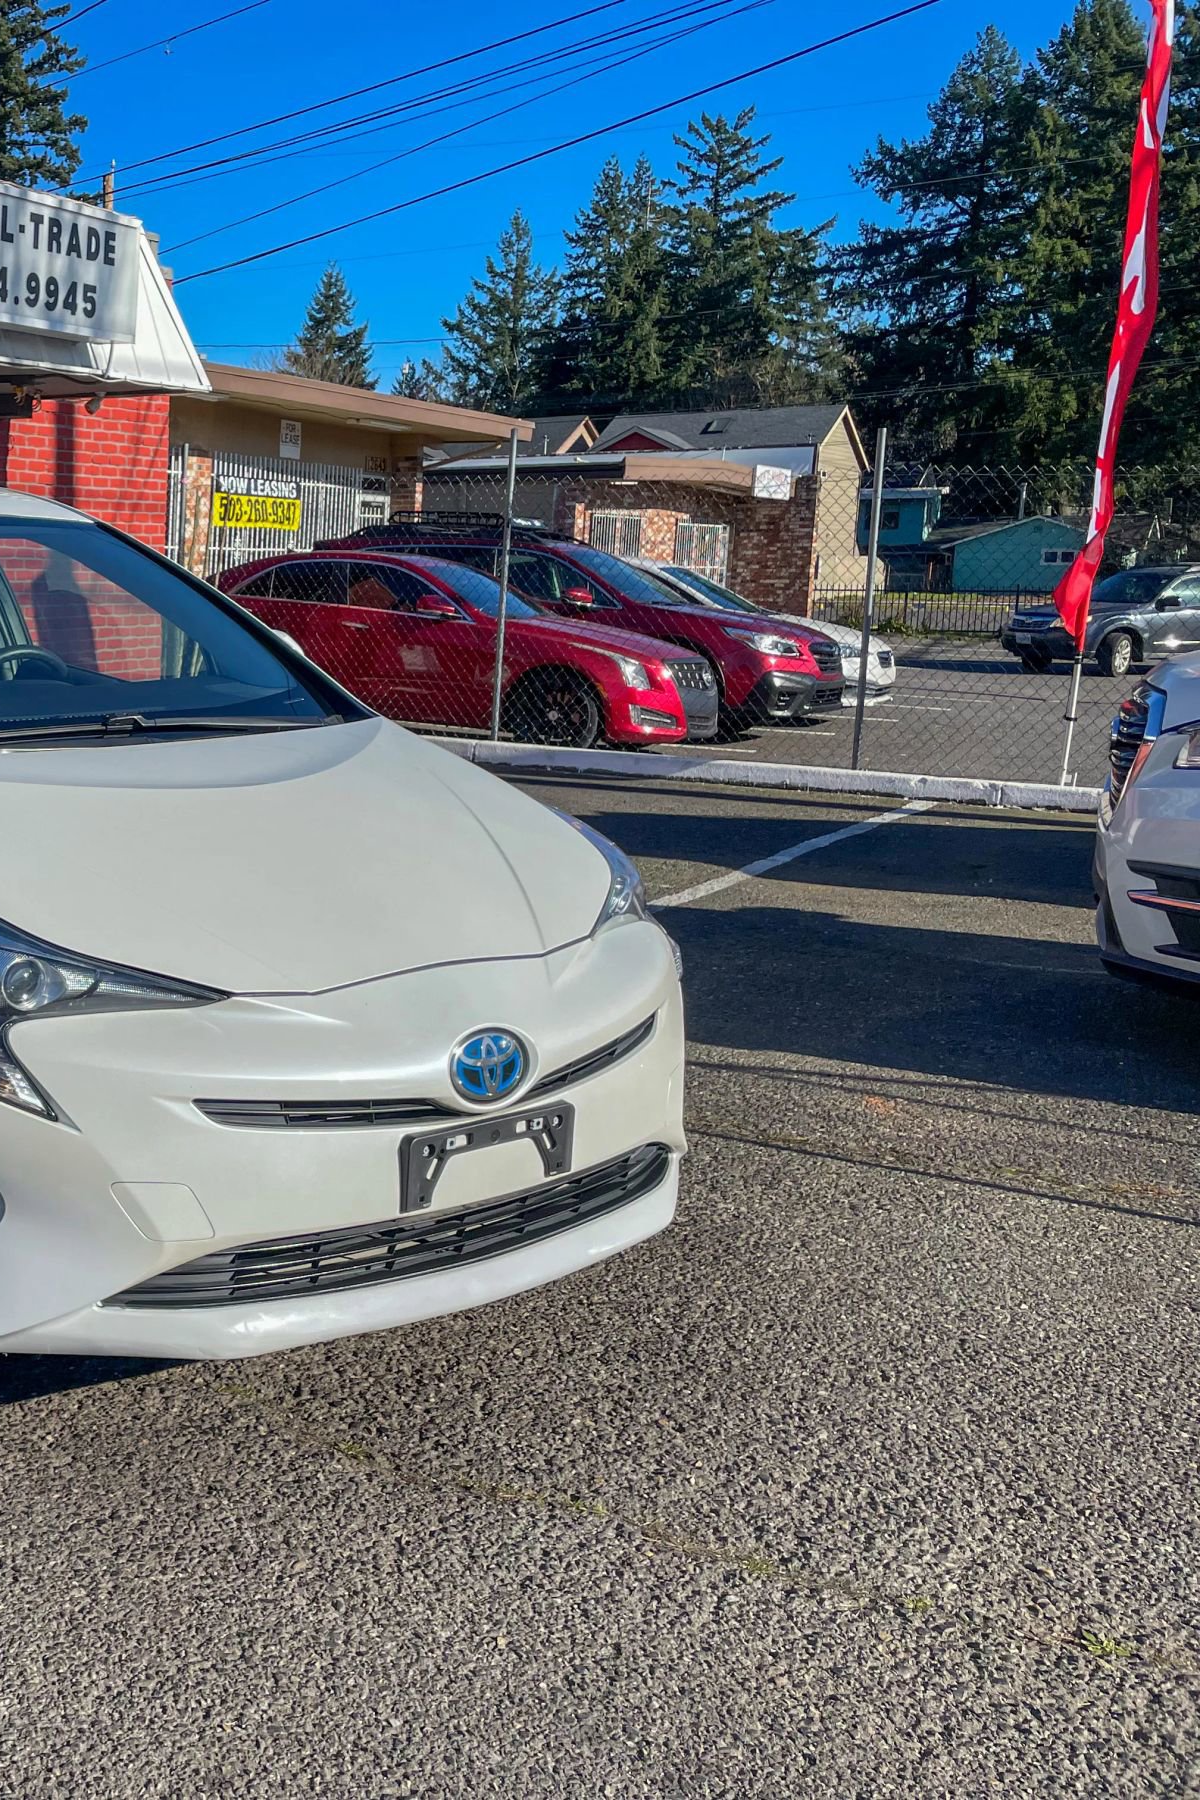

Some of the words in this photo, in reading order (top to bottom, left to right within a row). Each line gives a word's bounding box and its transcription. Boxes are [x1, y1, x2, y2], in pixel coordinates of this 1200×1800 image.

[281, 432, 300, 445] LEASE
[220, 476, 248, 494] NOW
[250, 478, 297, 498] LEASING
[219, 496, 296, 525] 503-260-9347
